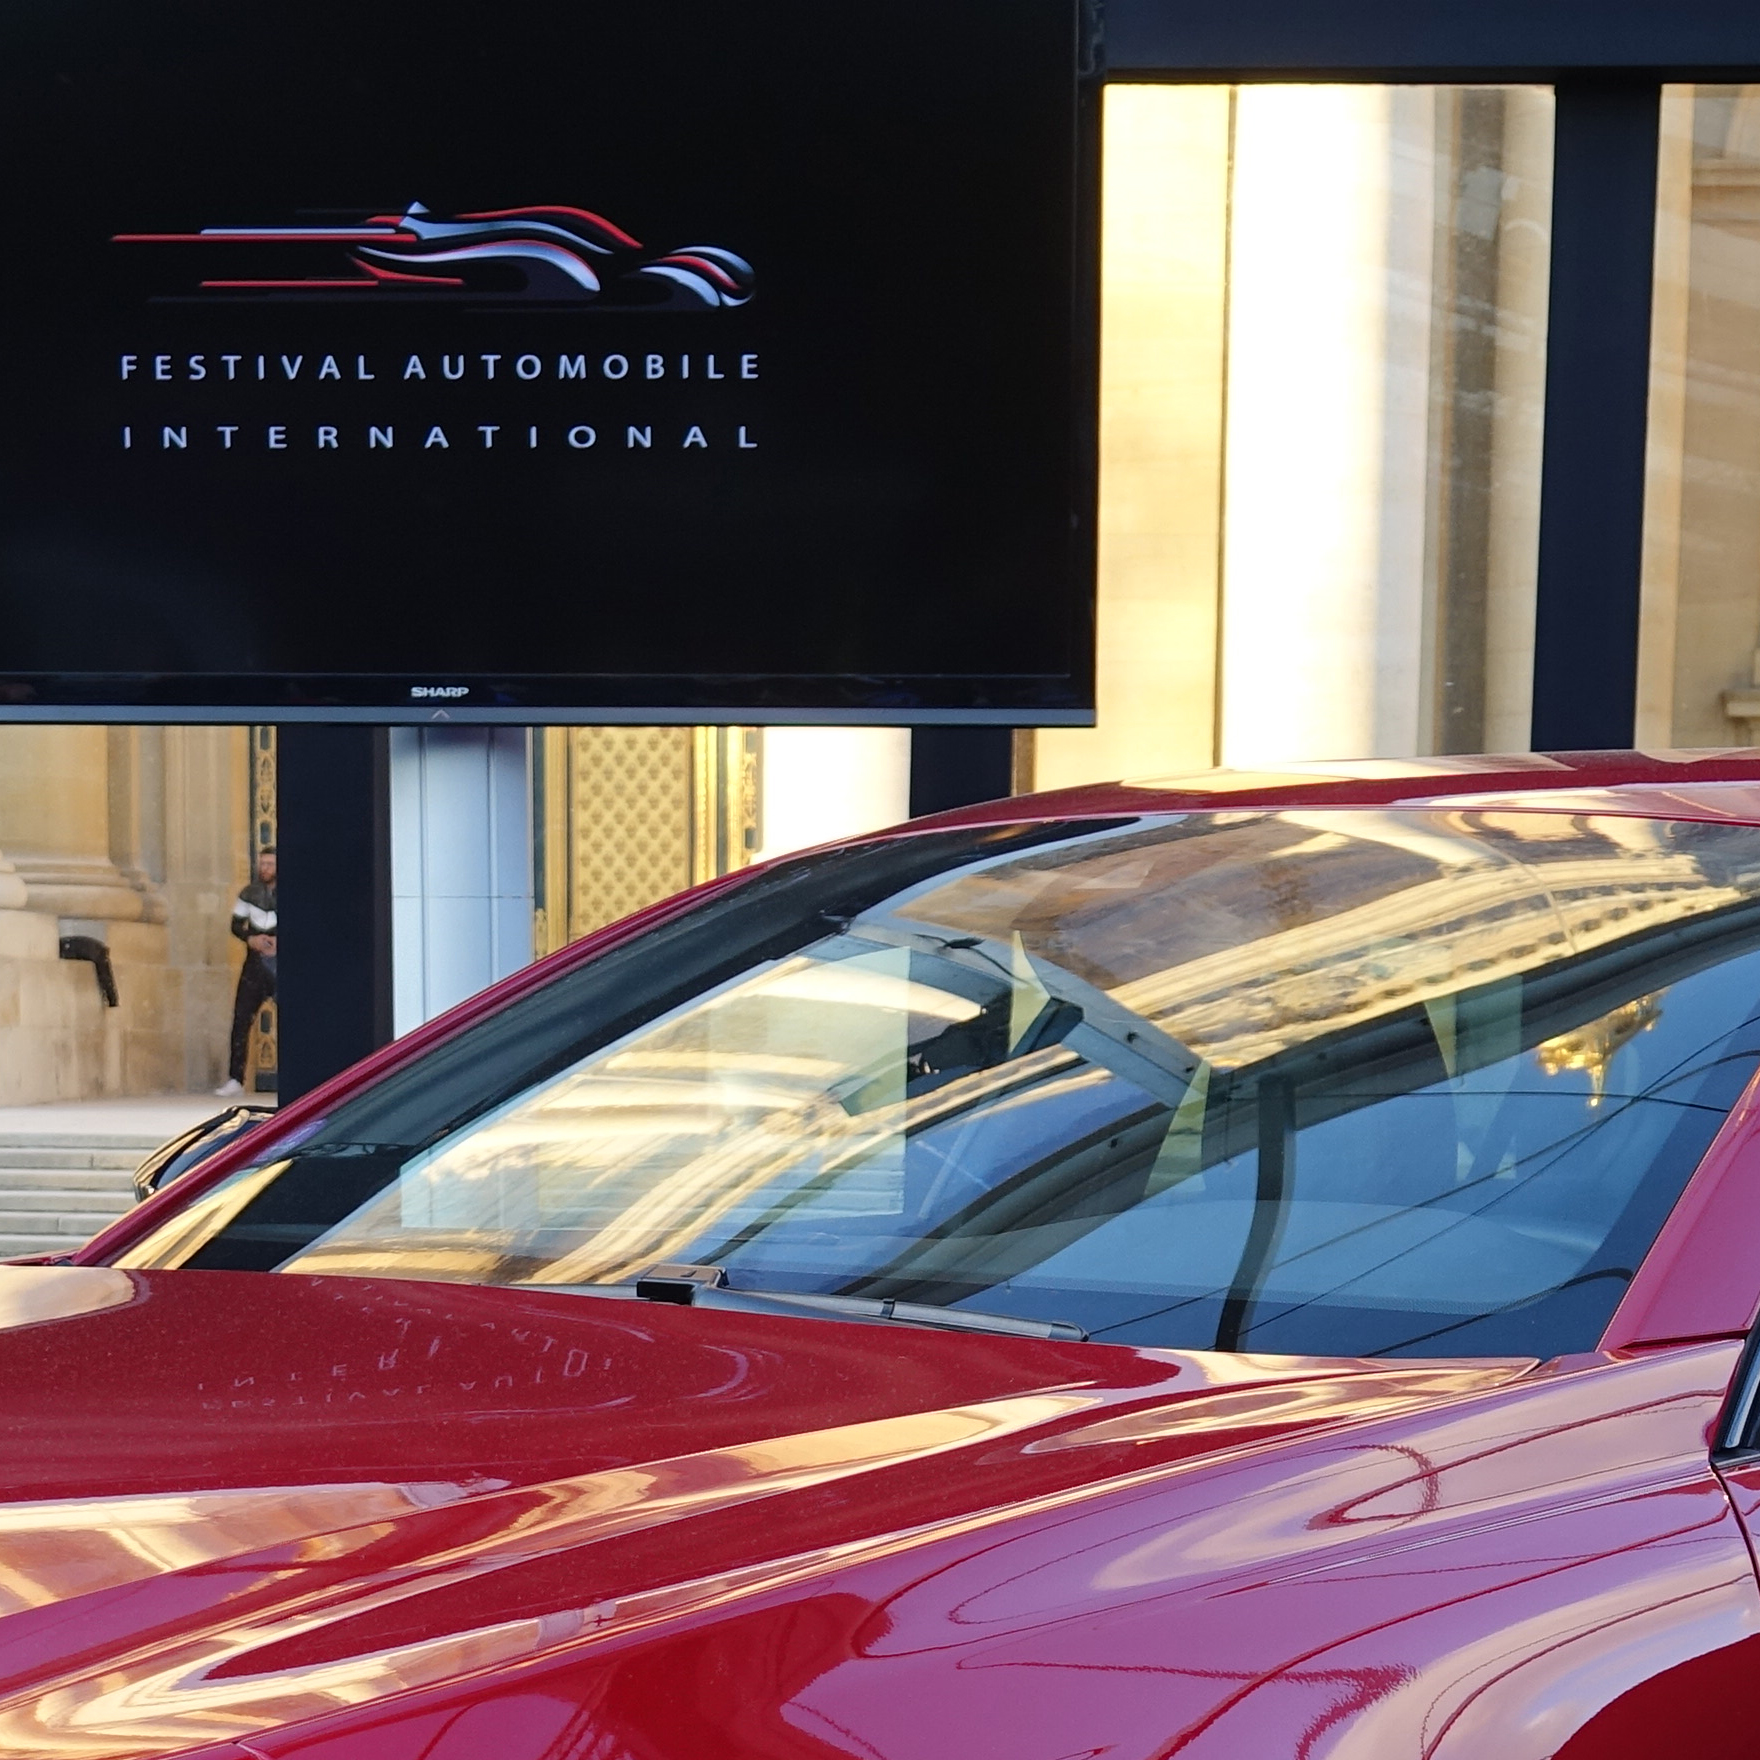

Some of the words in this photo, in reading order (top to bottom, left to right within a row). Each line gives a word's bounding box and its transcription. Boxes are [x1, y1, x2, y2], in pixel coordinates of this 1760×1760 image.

[121, 354, 376, 381] FESTIVAL
[403, 353, 760, 381] AUTOMOBILE
[123, 425, 758, 449] INTERNATIONAL
[411, 686, 470, 698] SHARP
